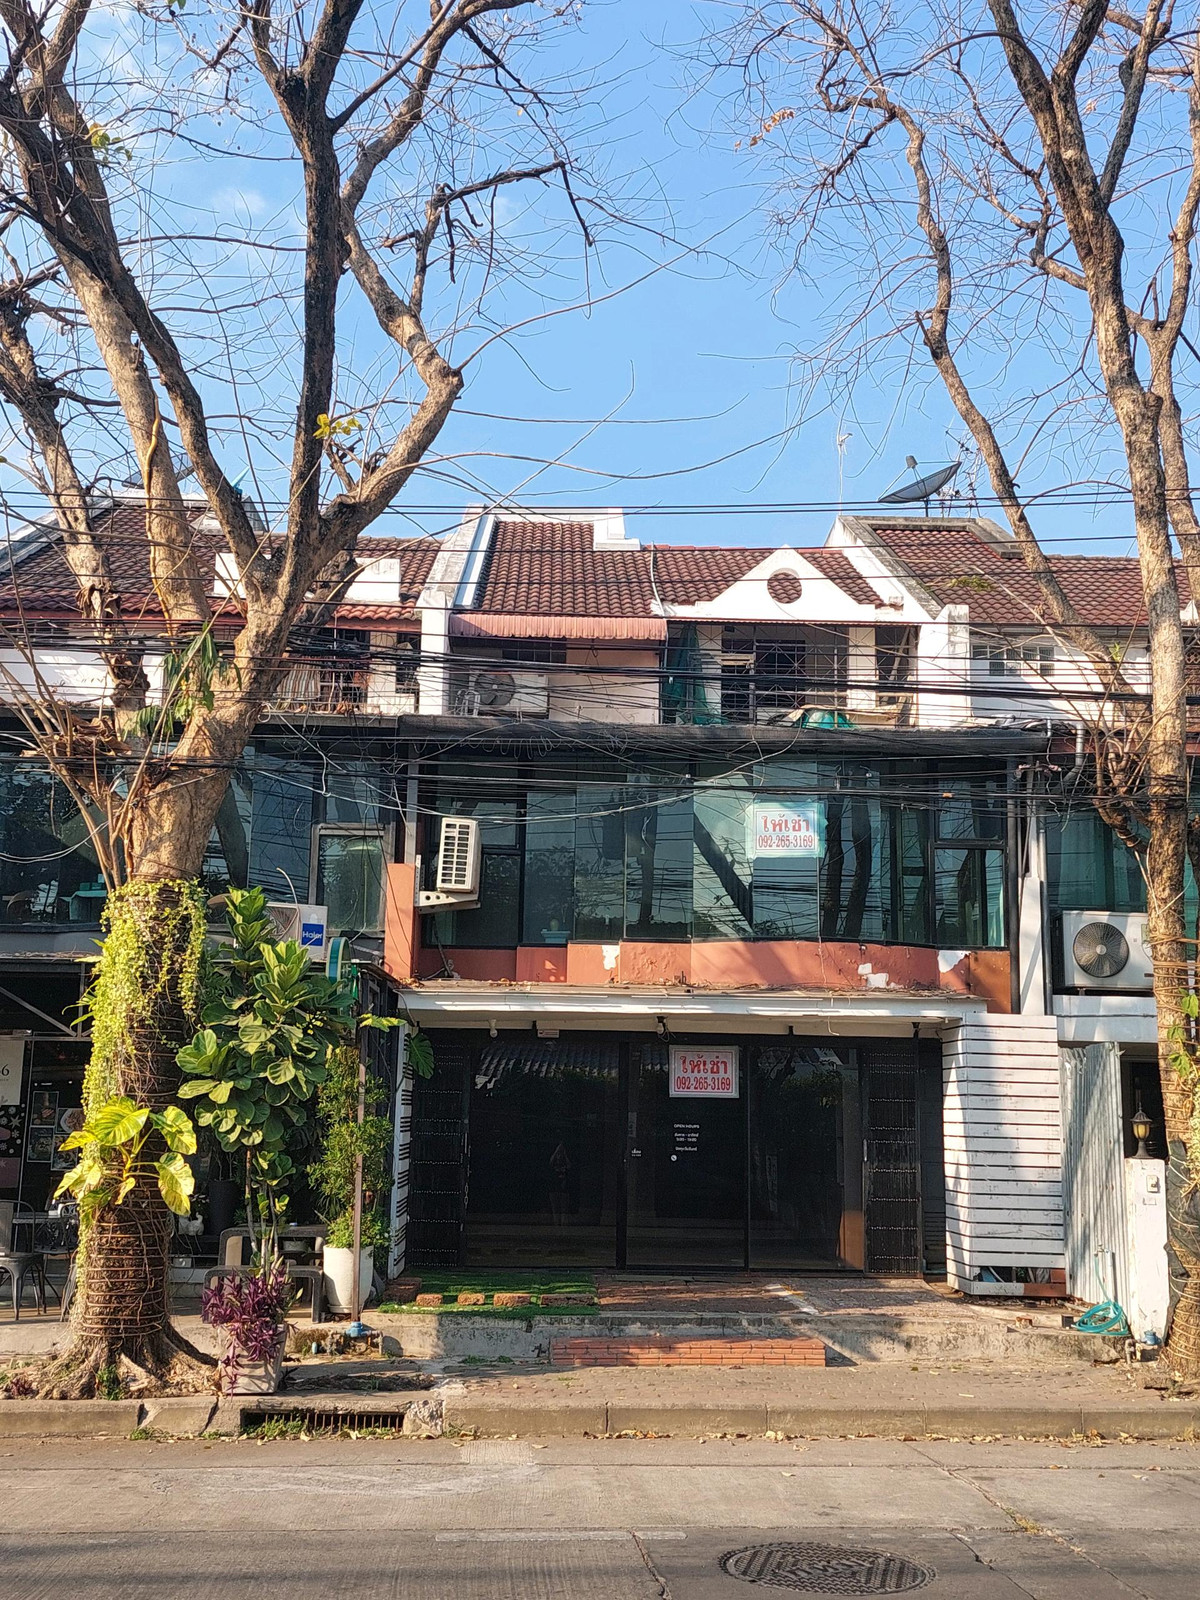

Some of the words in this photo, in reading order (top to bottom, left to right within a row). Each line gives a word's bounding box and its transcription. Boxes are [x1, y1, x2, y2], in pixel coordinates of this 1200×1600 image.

[761, 813, 810, 832] ให้เช่า
[758, 834, 813, 848] 092-265-3169
[680, 1054, 728, 1074] ให้เช่า
[676, 1076, 731, 1091] 092-265-3169
